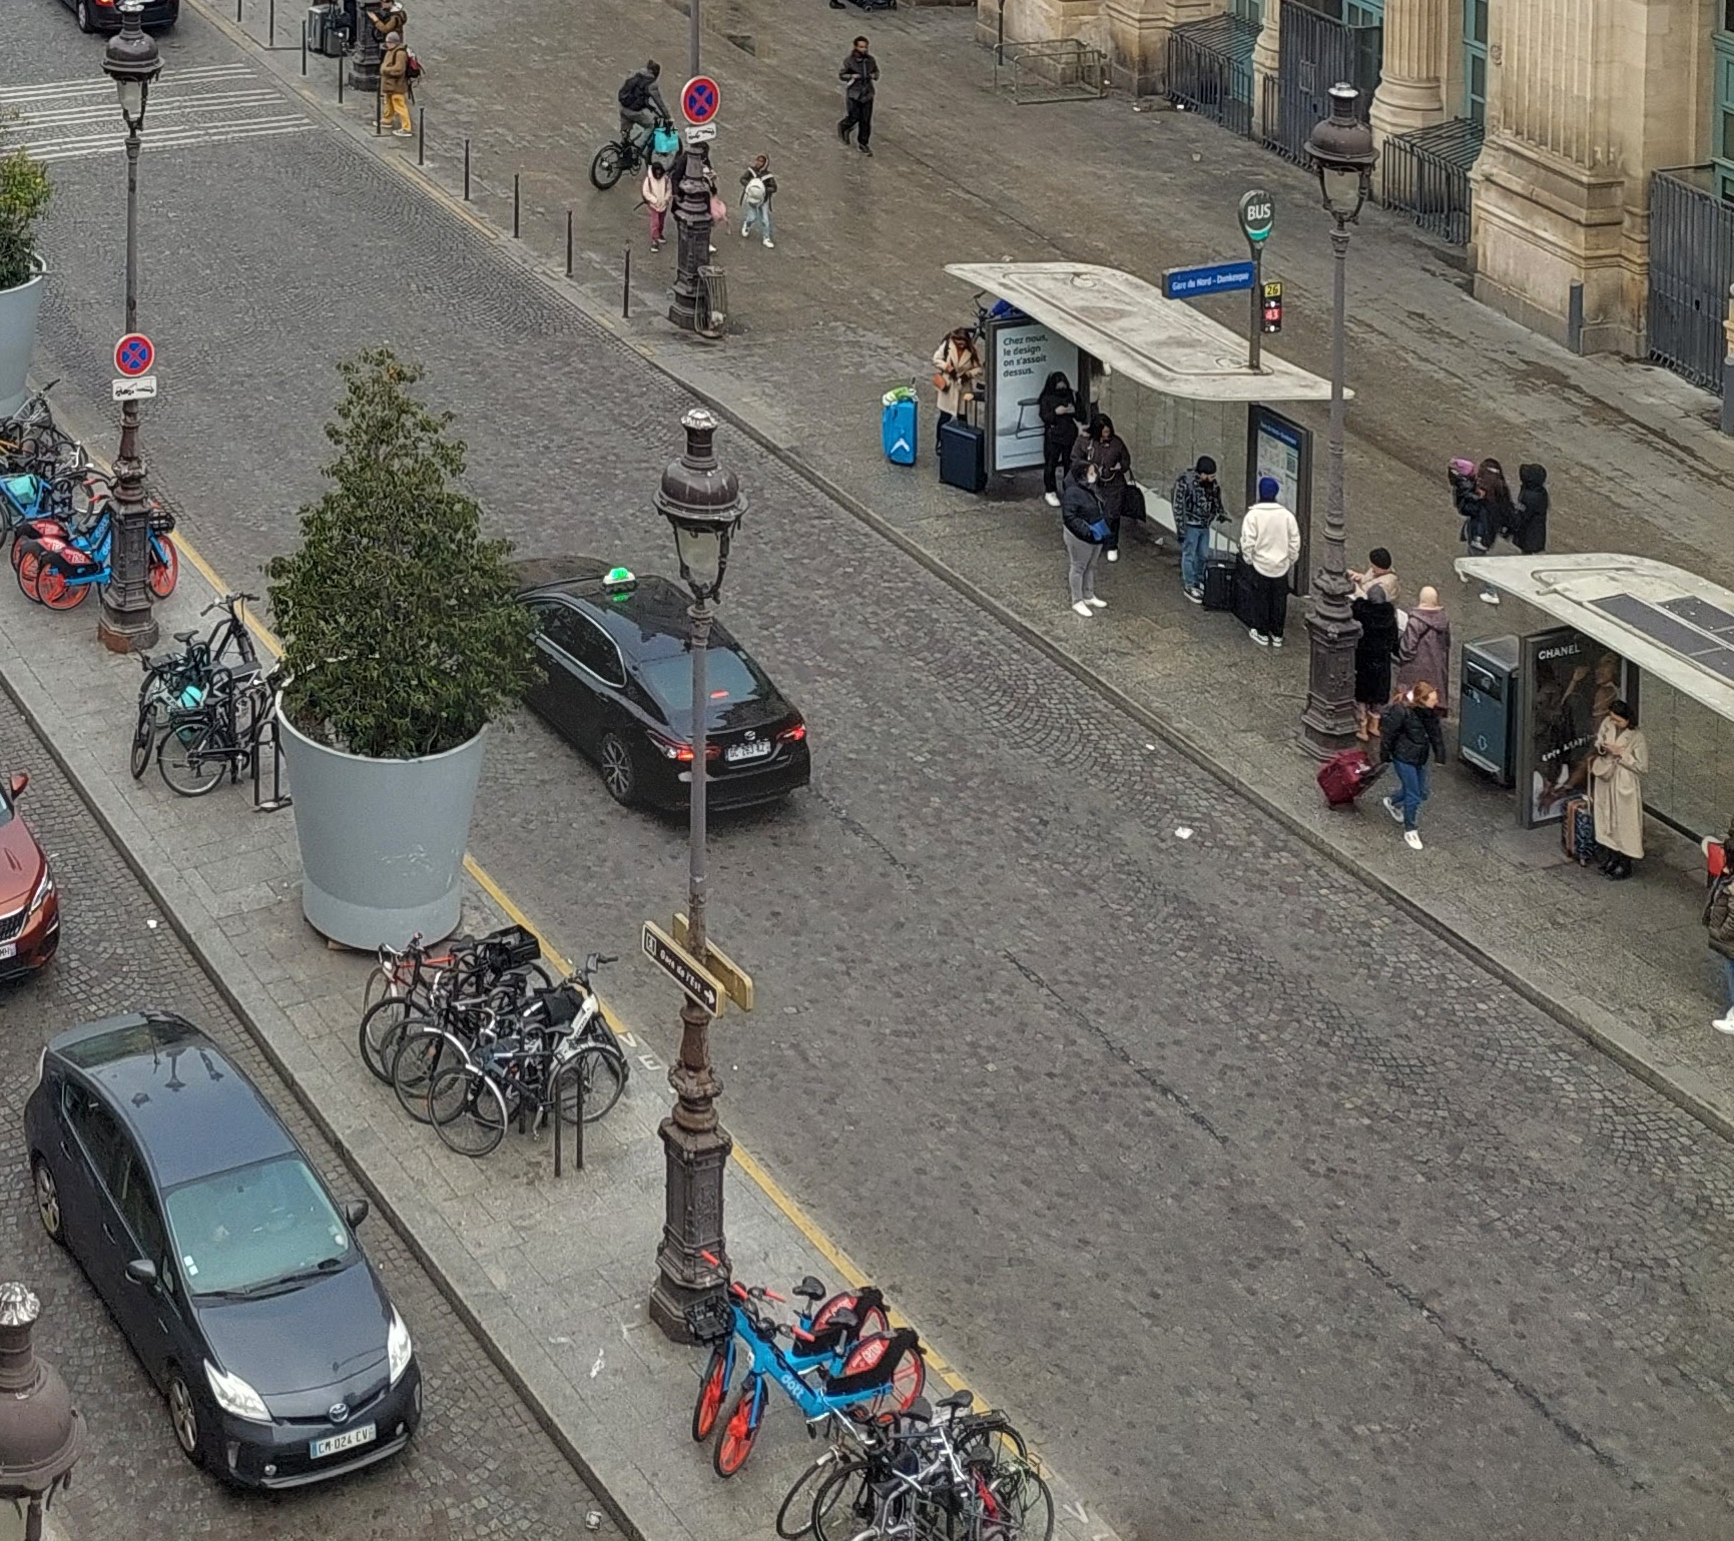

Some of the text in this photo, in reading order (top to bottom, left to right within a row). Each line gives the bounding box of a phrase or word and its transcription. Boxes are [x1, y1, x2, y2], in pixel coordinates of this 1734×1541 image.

[1247, 202, 1271, 221] BUS
[1172, 281, 1186, 291] Gare
[1187, 279, 1196, 288] du
[1197, 276, 1212, 287] Nord
[1267, 284, 1278, 295] 26
[1265, 308, 1279, 321] 43
[1003, 334, 1048, 346] Chez nous,
[1003, 345, 1041, 357] le design
[1003, 354, 1047, 367] on s'assoit
[1003, 368, 1034, 378] dessus.
[1538, 644, 1581, 660] CHANEL
[660, 949, 675, 970] Gare
